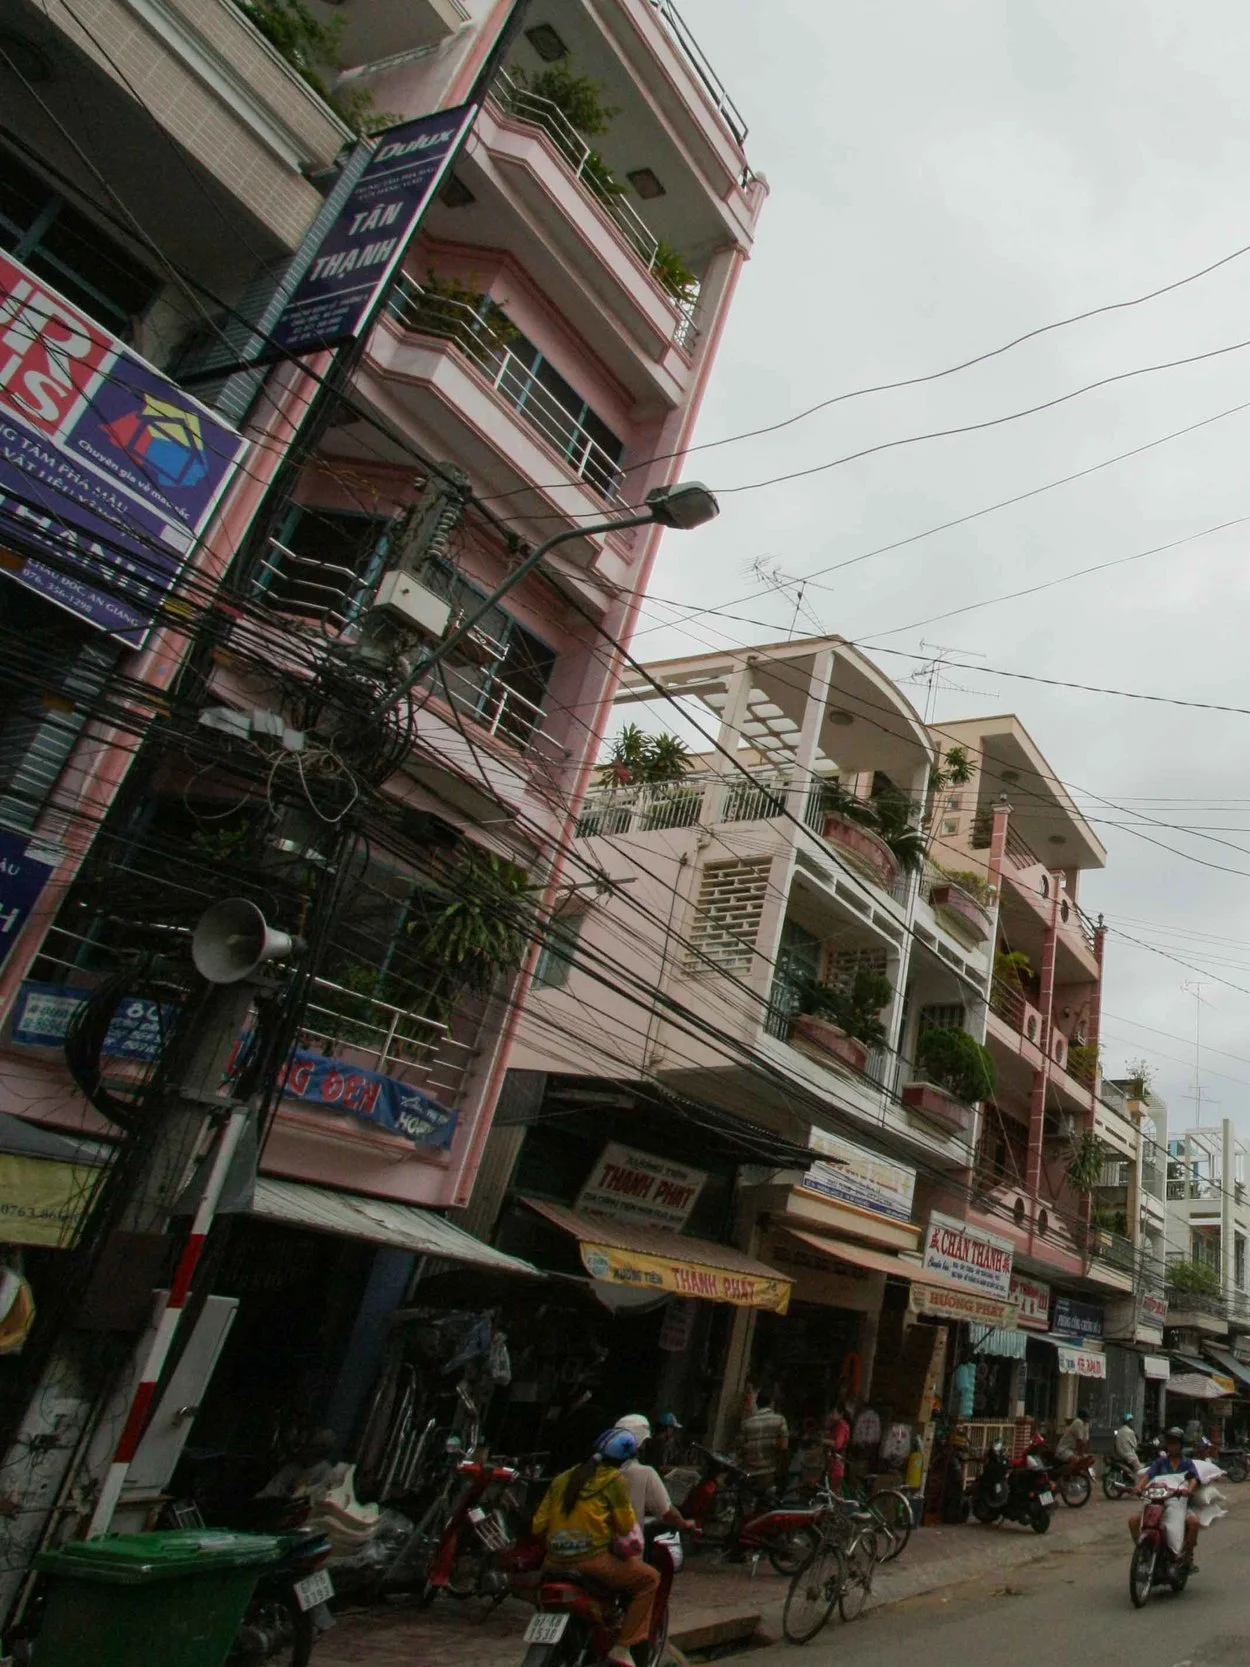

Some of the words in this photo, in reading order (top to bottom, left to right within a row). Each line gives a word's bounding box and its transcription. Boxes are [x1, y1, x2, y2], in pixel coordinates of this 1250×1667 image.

[373, 130, 455, 163] Dulux
[347, 201, 406, 235] TÂN
[310, 237, 399, 282] THẠNH
[20, 435, 56, 466] TÂM
